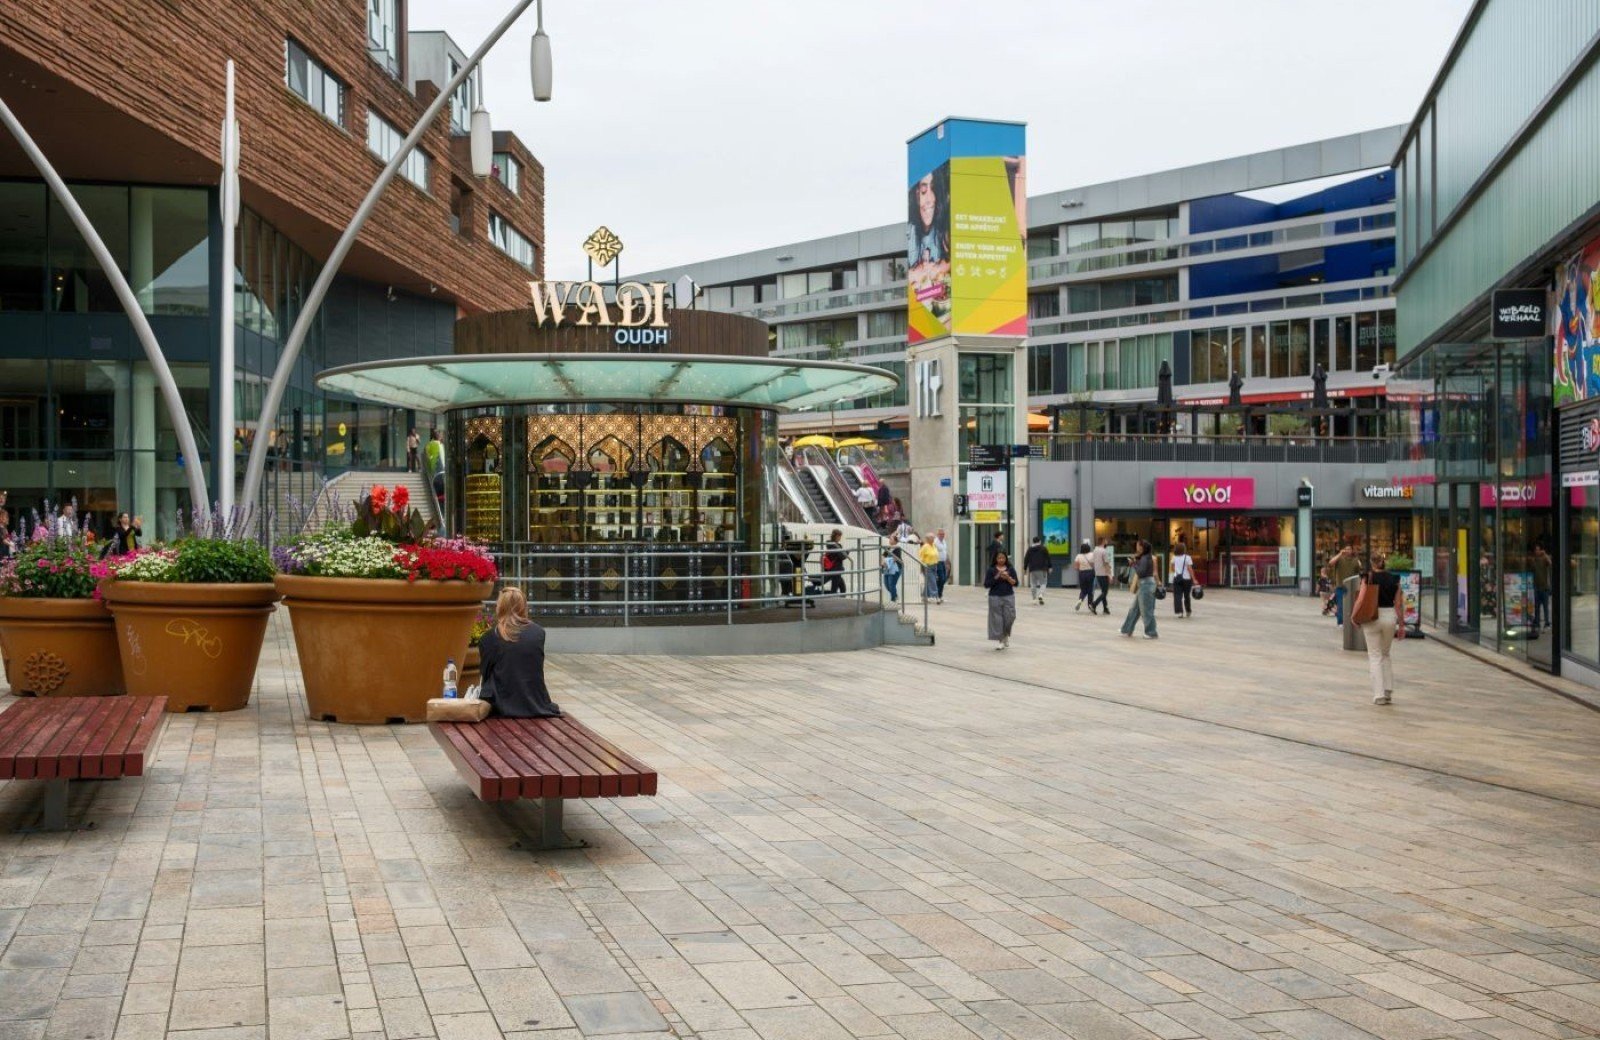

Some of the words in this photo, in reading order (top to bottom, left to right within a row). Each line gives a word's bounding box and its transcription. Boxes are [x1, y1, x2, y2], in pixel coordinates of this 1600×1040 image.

[526, 281, 669, 328] WADI
[1499, 314, 1541, 322] VERHAAL
[615, 329, 668, 344] OUDH
[1184, 484, 1231, 503] YOYO!
